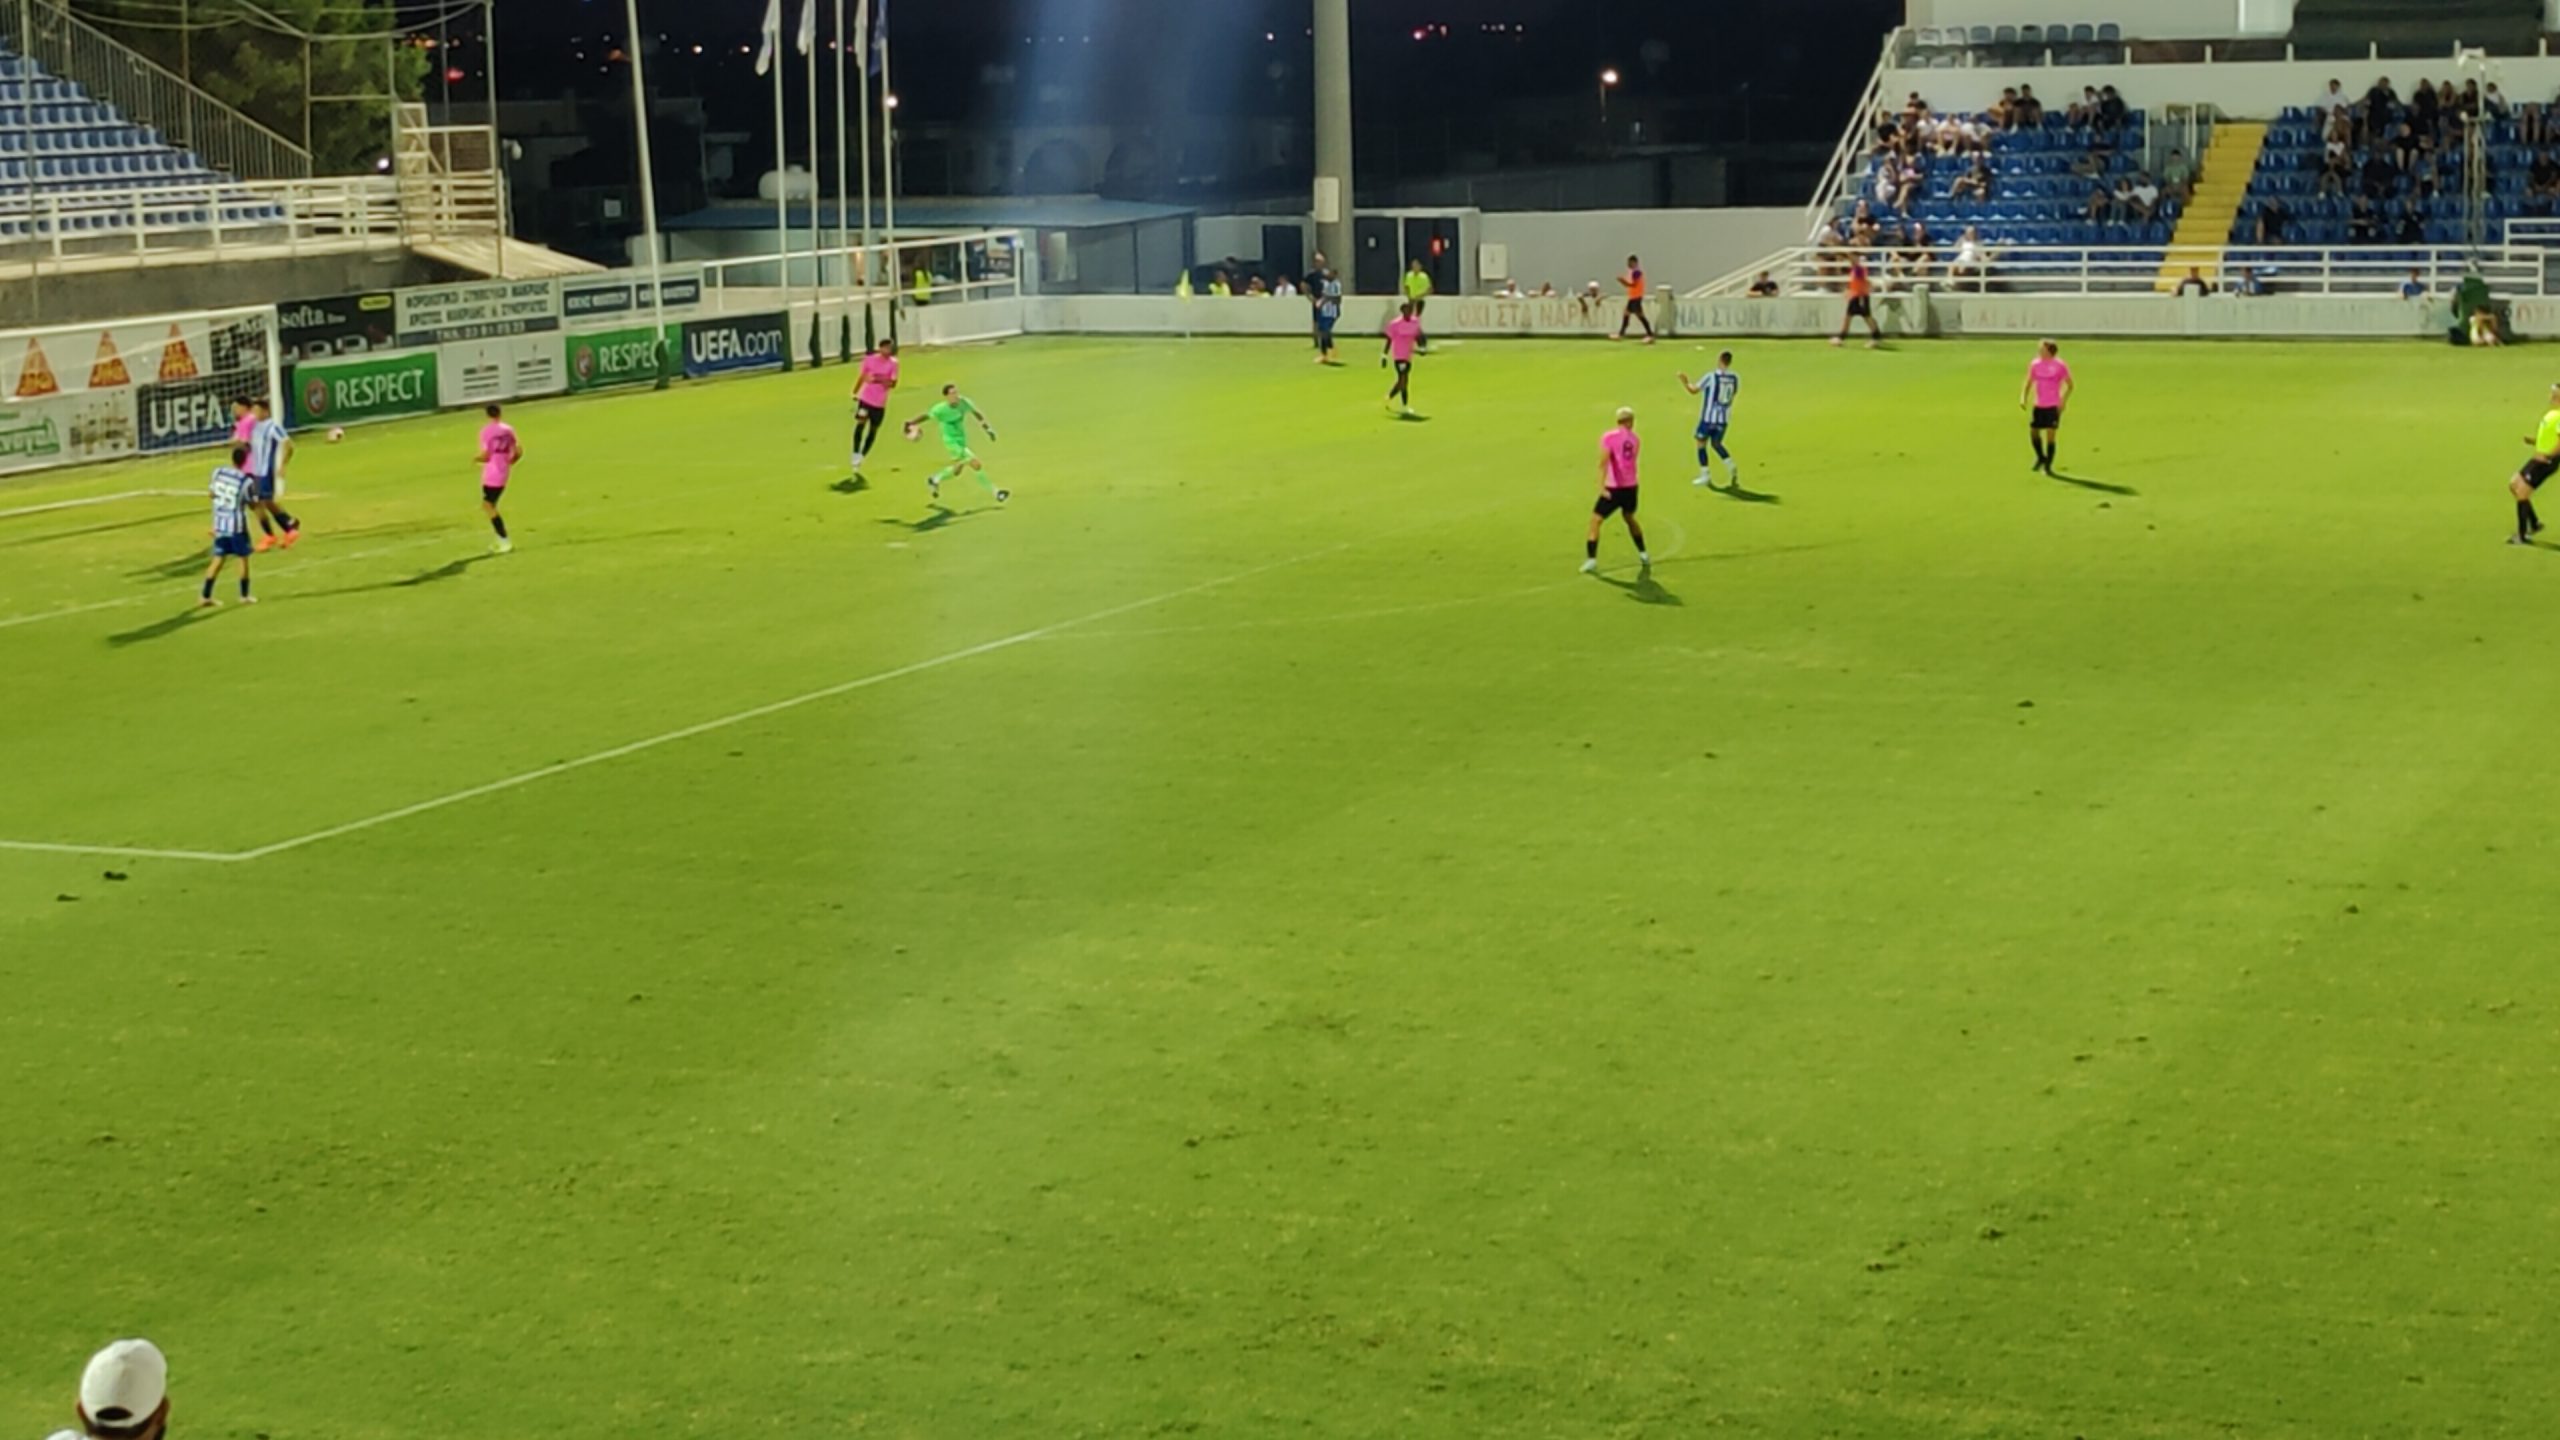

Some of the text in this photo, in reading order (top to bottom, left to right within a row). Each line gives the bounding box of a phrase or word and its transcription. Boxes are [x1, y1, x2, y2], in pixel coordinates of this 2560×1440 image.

[690, 327, 783, 363] UEFA.com
[335, 368, 425, 409] RESPECT
[150, 391, 231, 437] UEFA
